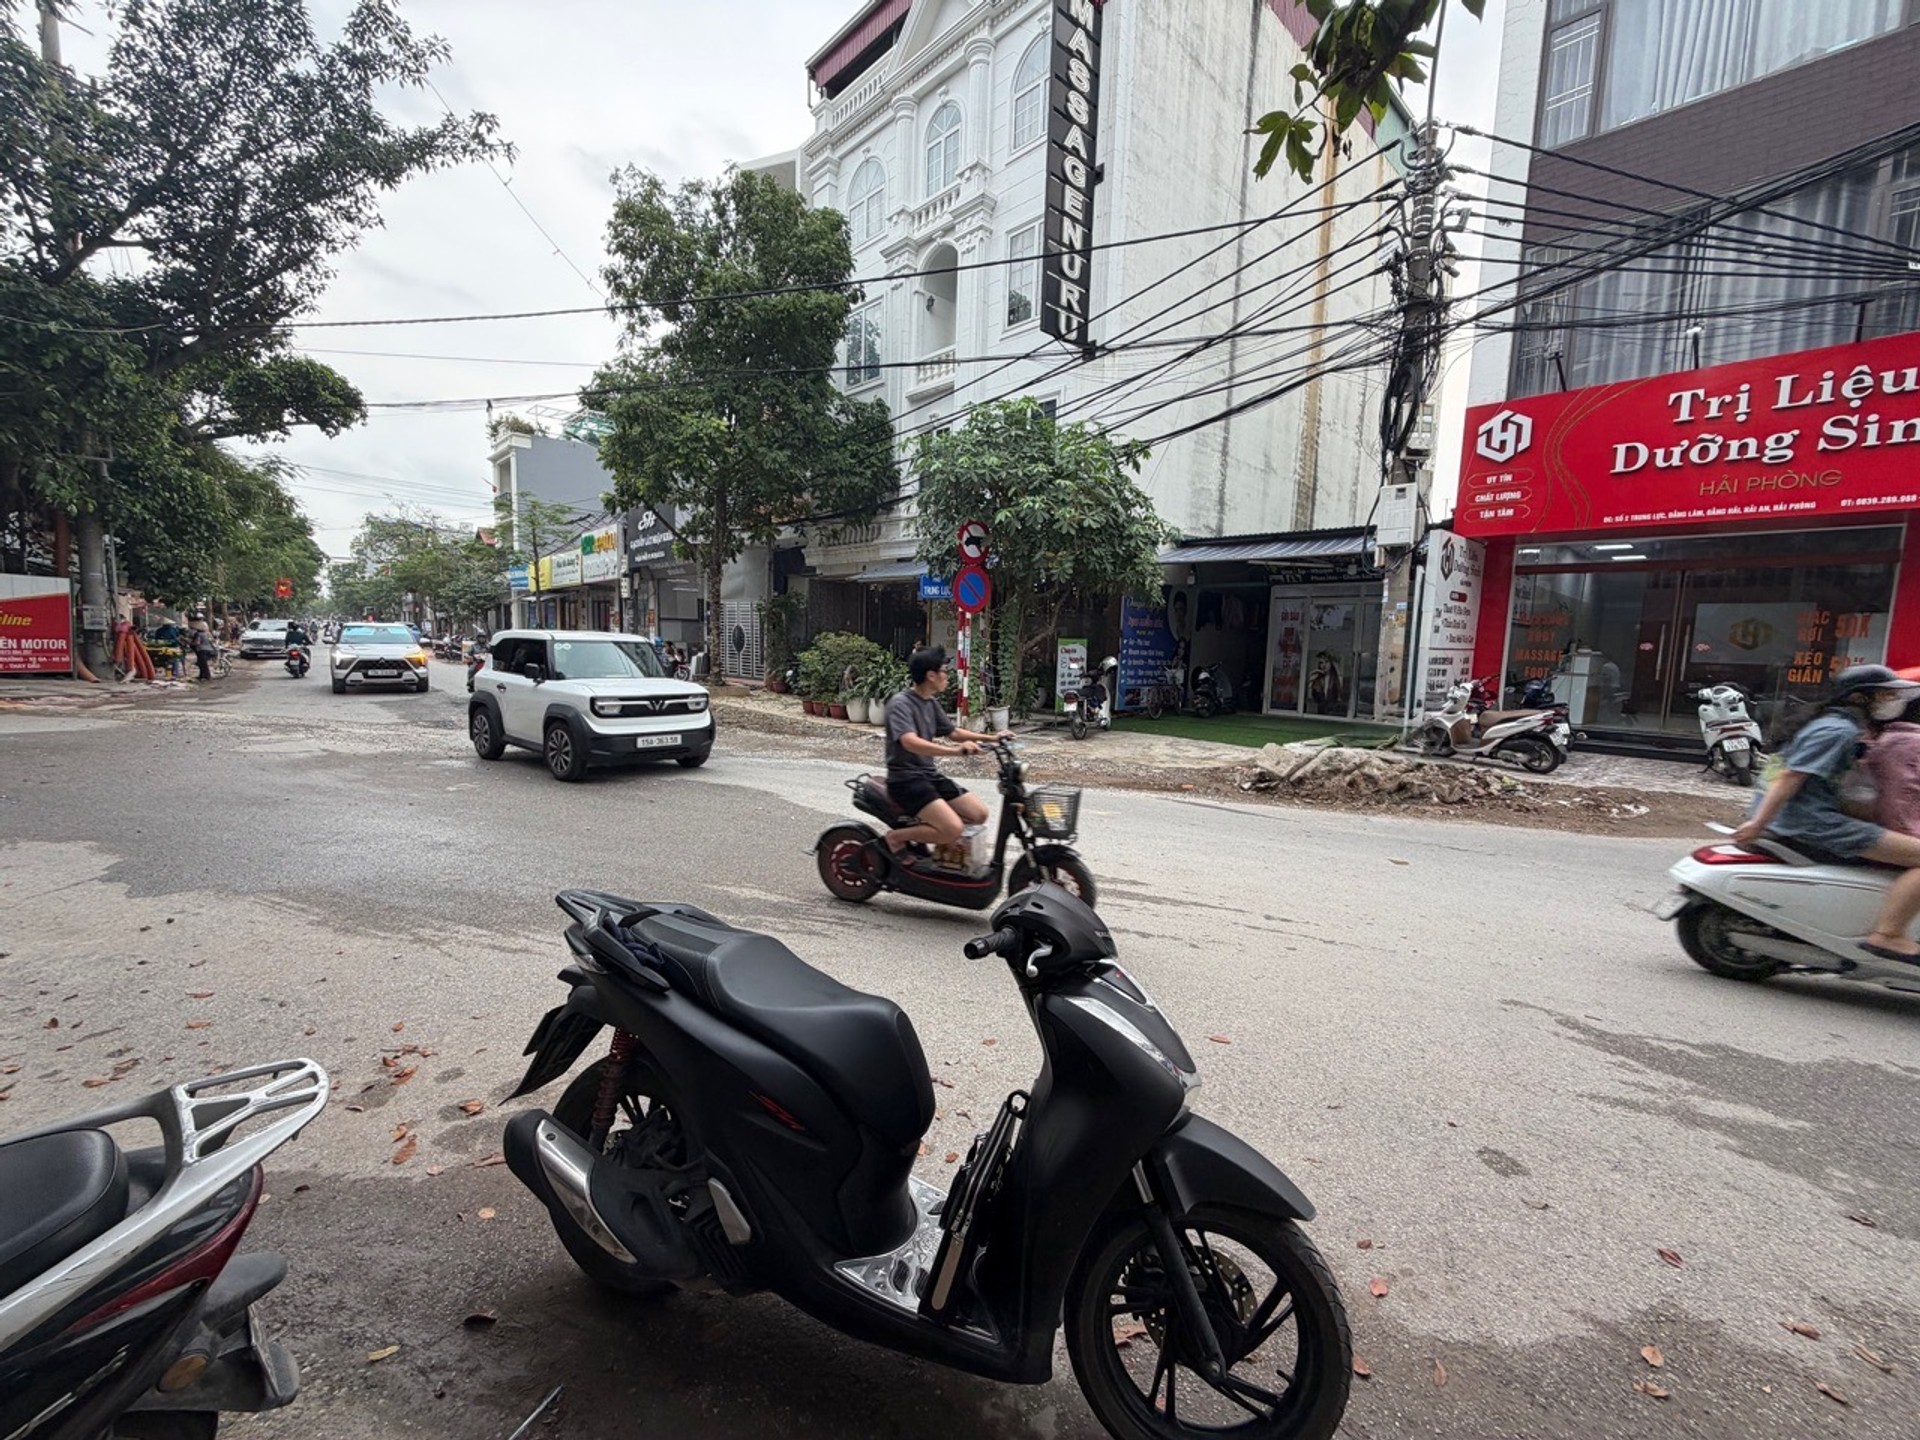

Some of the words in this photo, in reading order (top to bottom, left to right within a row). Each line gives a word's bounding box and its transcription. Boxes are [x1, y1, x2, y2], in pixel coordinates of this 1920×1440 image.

[1668, 384, 1751, 422] Trị
[1771, 364, 1920, 410] Liệu
[1609, 429, 1801, 474] Dưỡng
[1486, 476, 1497, 484] UY
[1700, 474, 1738, 496] HẢI
[1746, 468, 1843, 492] PHÒNG
[0, 613, 32, 625] line
[21, 638, 67, 649] MOTOR
